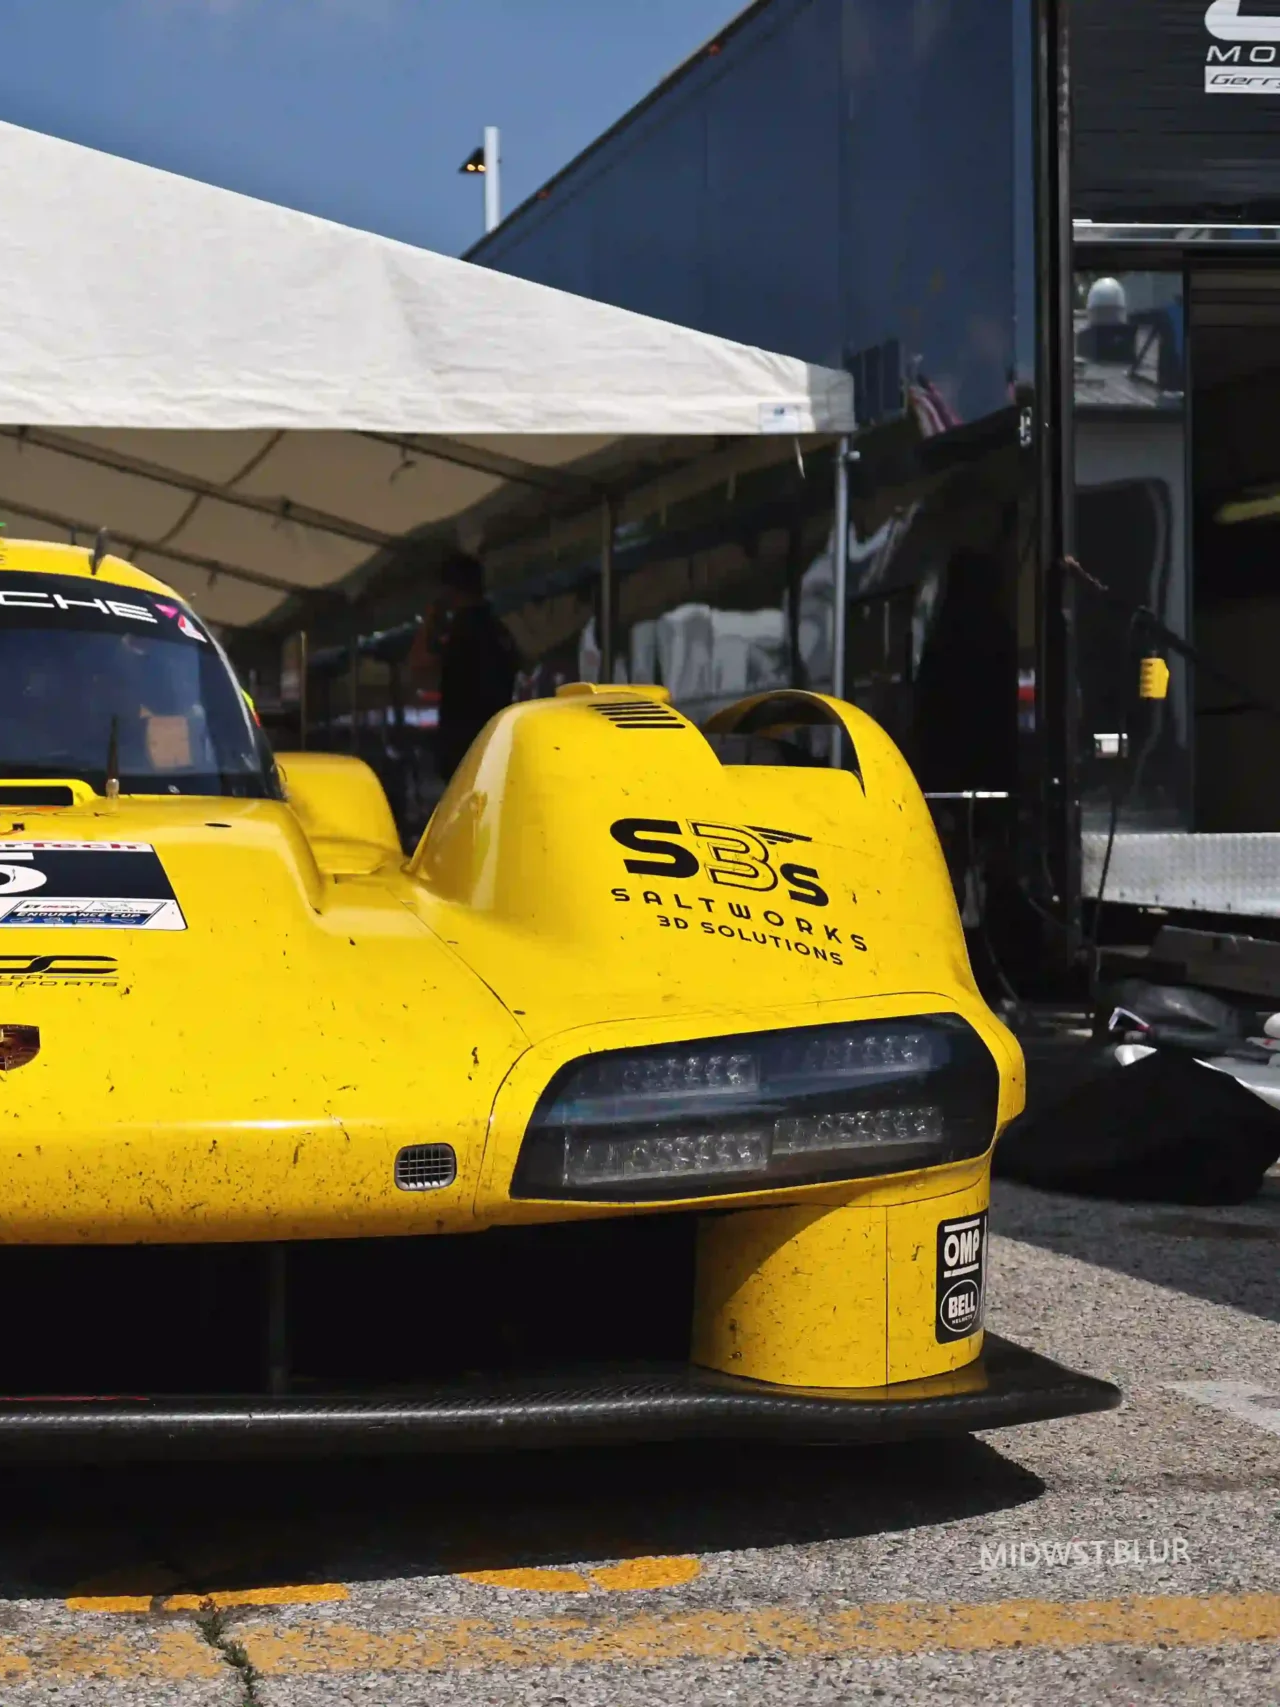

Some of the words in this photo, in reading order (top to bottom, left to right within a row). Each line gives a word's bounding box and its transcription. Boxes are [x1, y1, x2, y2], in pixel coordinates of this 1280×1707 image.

[610, 888, 868, 952] SALTWORKS
[656, 915, 688, 929] 3D
[700, 922, 844, 966] SOLUTIONS
[944, 1228, 980, 1268] OMP
[948, 1291, 976, 1319] BELL
